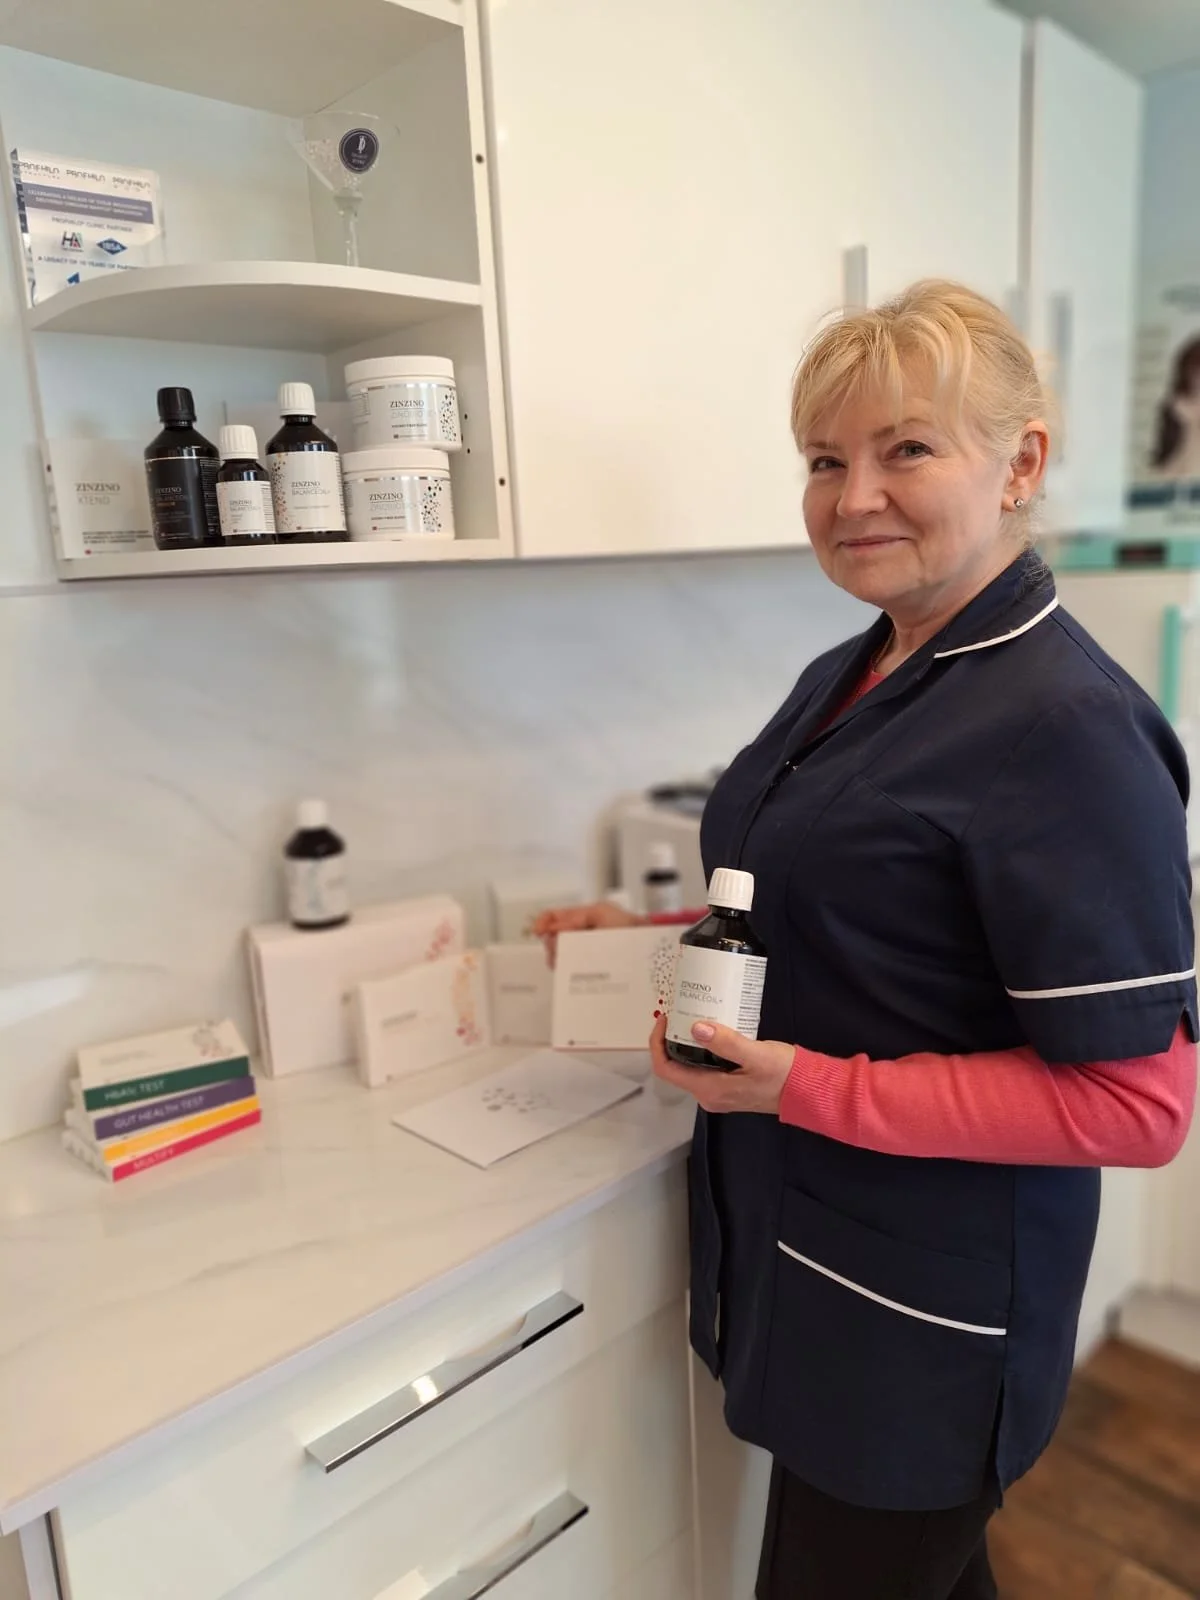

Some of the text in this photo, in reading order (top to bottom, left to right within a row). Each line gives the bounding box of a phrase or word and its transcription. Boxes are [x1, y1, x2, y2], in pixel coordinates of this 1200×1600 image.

[389, 399, 425, 409] ZINZINO
[75, 482, 121, 492] ZINZINO
[369, 492, 404, 502] ZINZINO
[681, 980, 712, 994] ZINZINO
[139, 1079, 165, 1093] TEST
[113, 1095, 205, 1129] GUT HEALTH TEST
